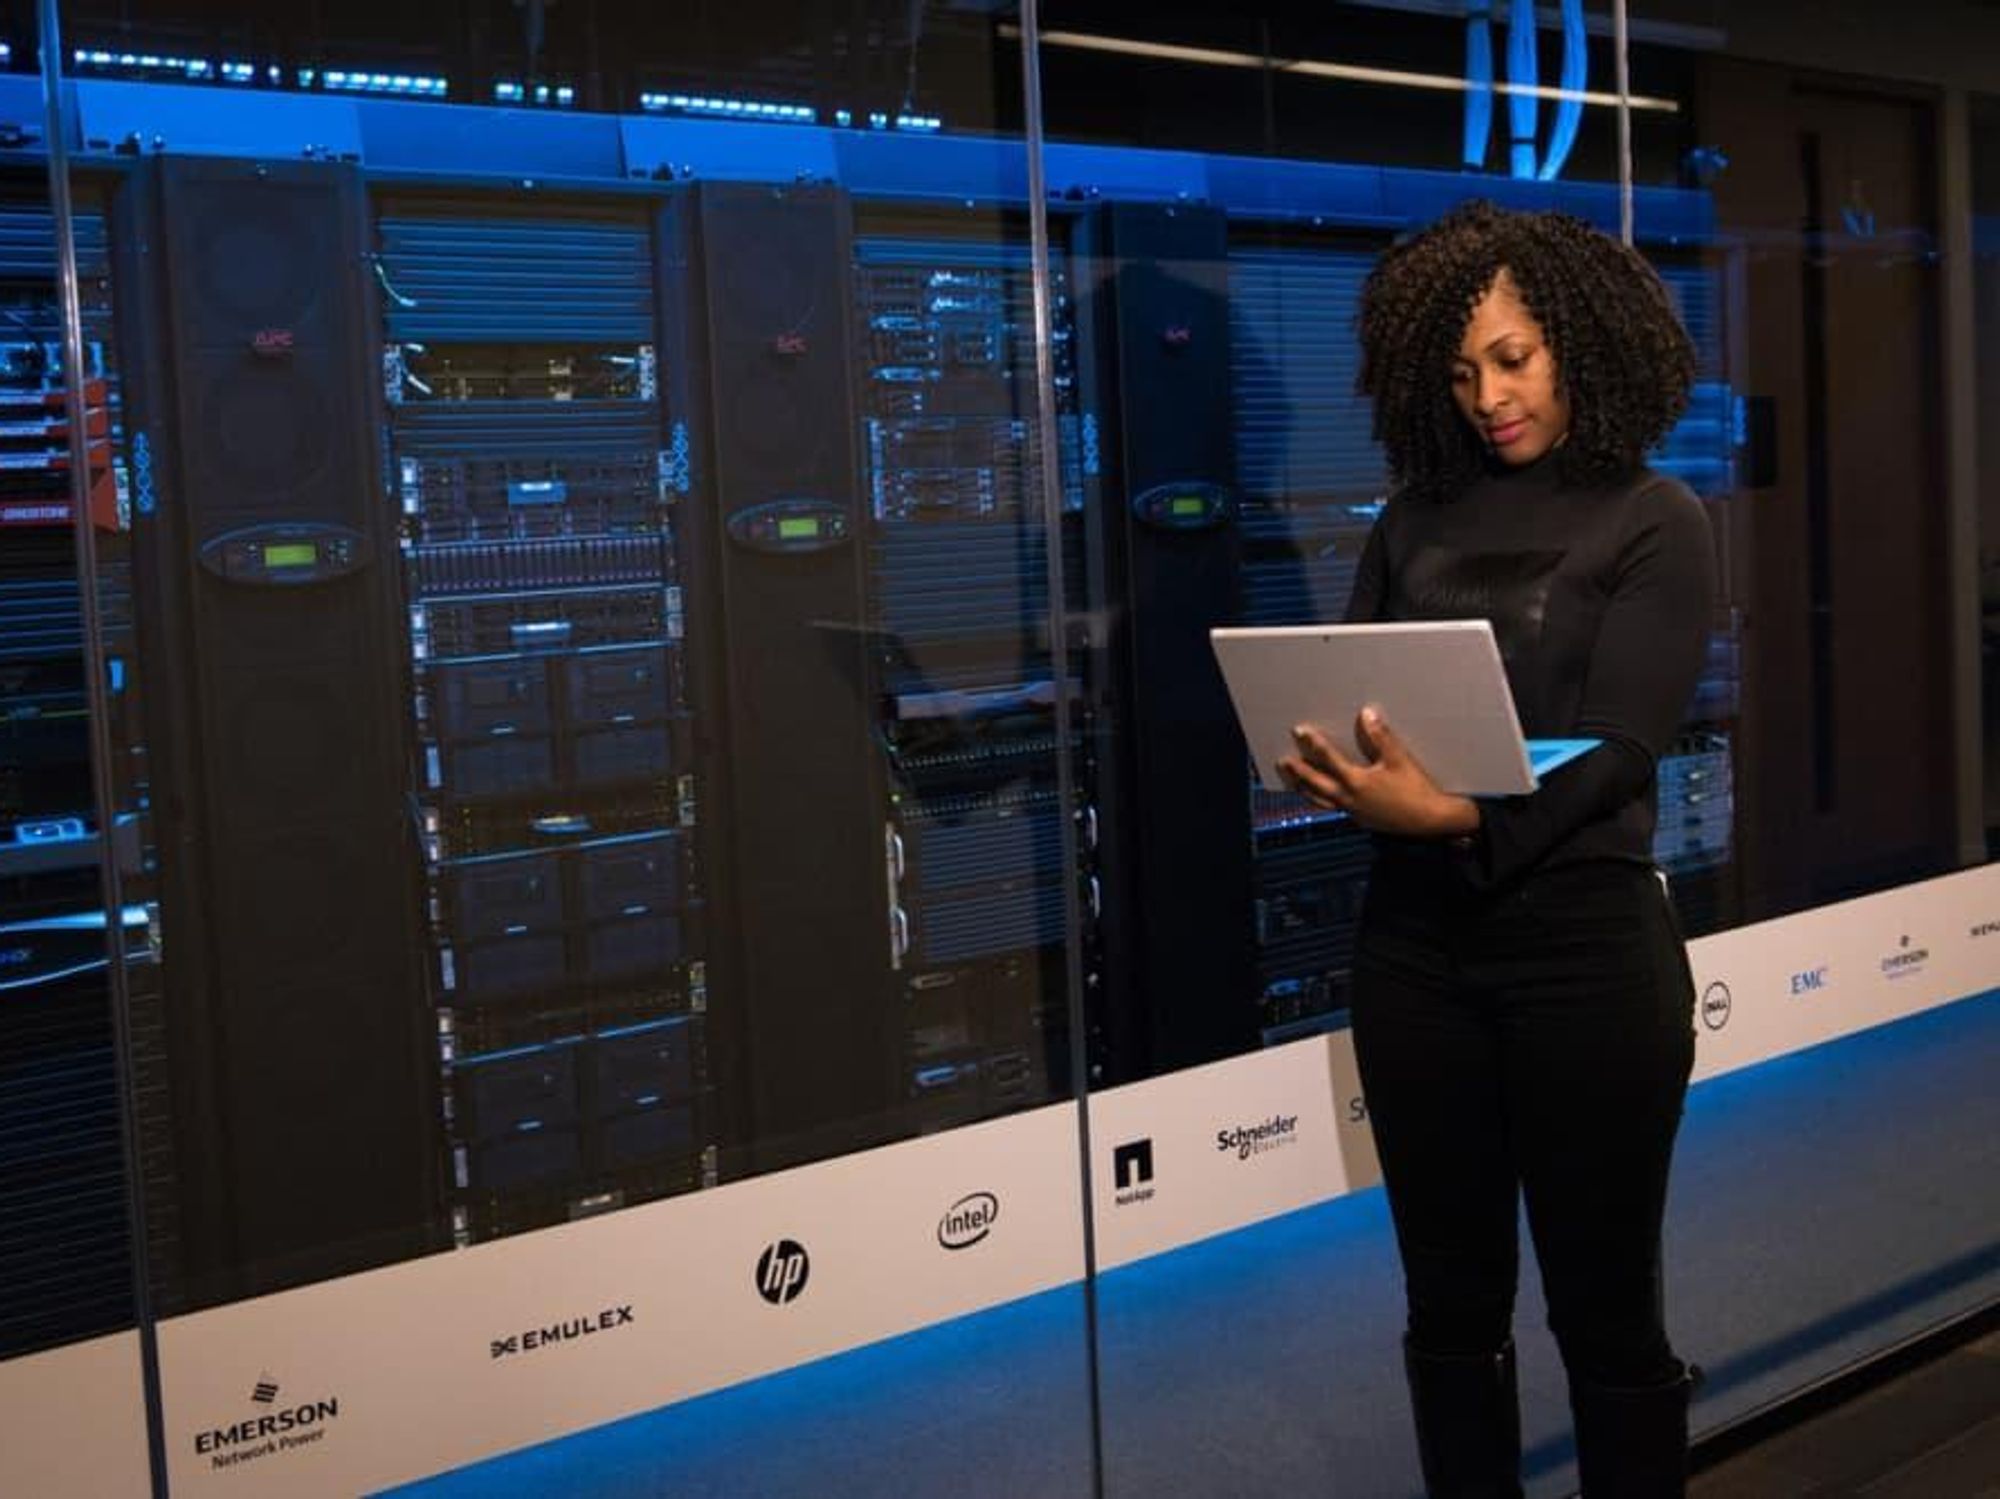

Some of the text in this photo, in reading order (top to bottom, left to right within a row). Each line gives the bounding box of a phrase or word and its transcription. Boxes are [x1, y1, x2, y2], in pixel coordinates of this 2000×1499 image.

[1791, 968, 1828, 994] EMC
[1217, 1114, 1298, 1152] Schneider
[945, 1203, 990, 1235] intel
[760, 1239, 807, 1304] hp
[522, 1305, 634, 1350] EMULEX
[195, 1396, 338, 1455] EMERSON
[212, 1429, 325, 1470] Network Power
